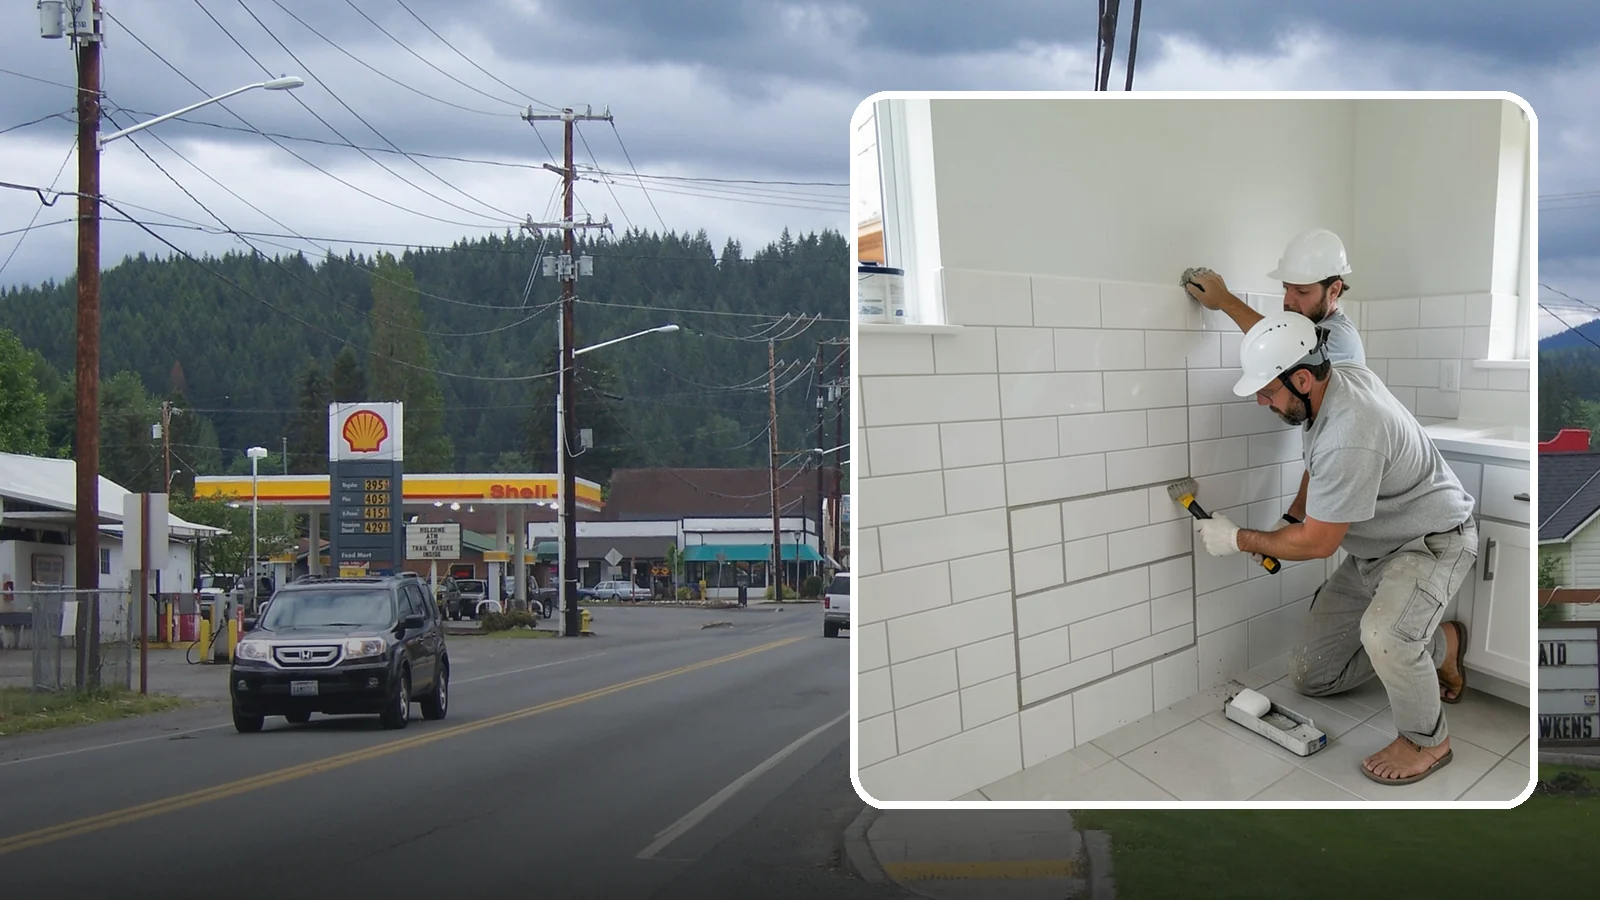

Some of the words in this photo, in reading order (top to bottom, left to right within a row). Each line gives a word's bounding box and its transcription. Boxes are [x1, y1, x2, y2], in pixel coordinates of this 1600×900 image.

[366, 480, 383, 490] 395
[490, 484, 547, 498] Shell
[366, 494, 383, 504] 405
[366, 508, 383, 518] 415
[366, 522, 383, 532] 429
